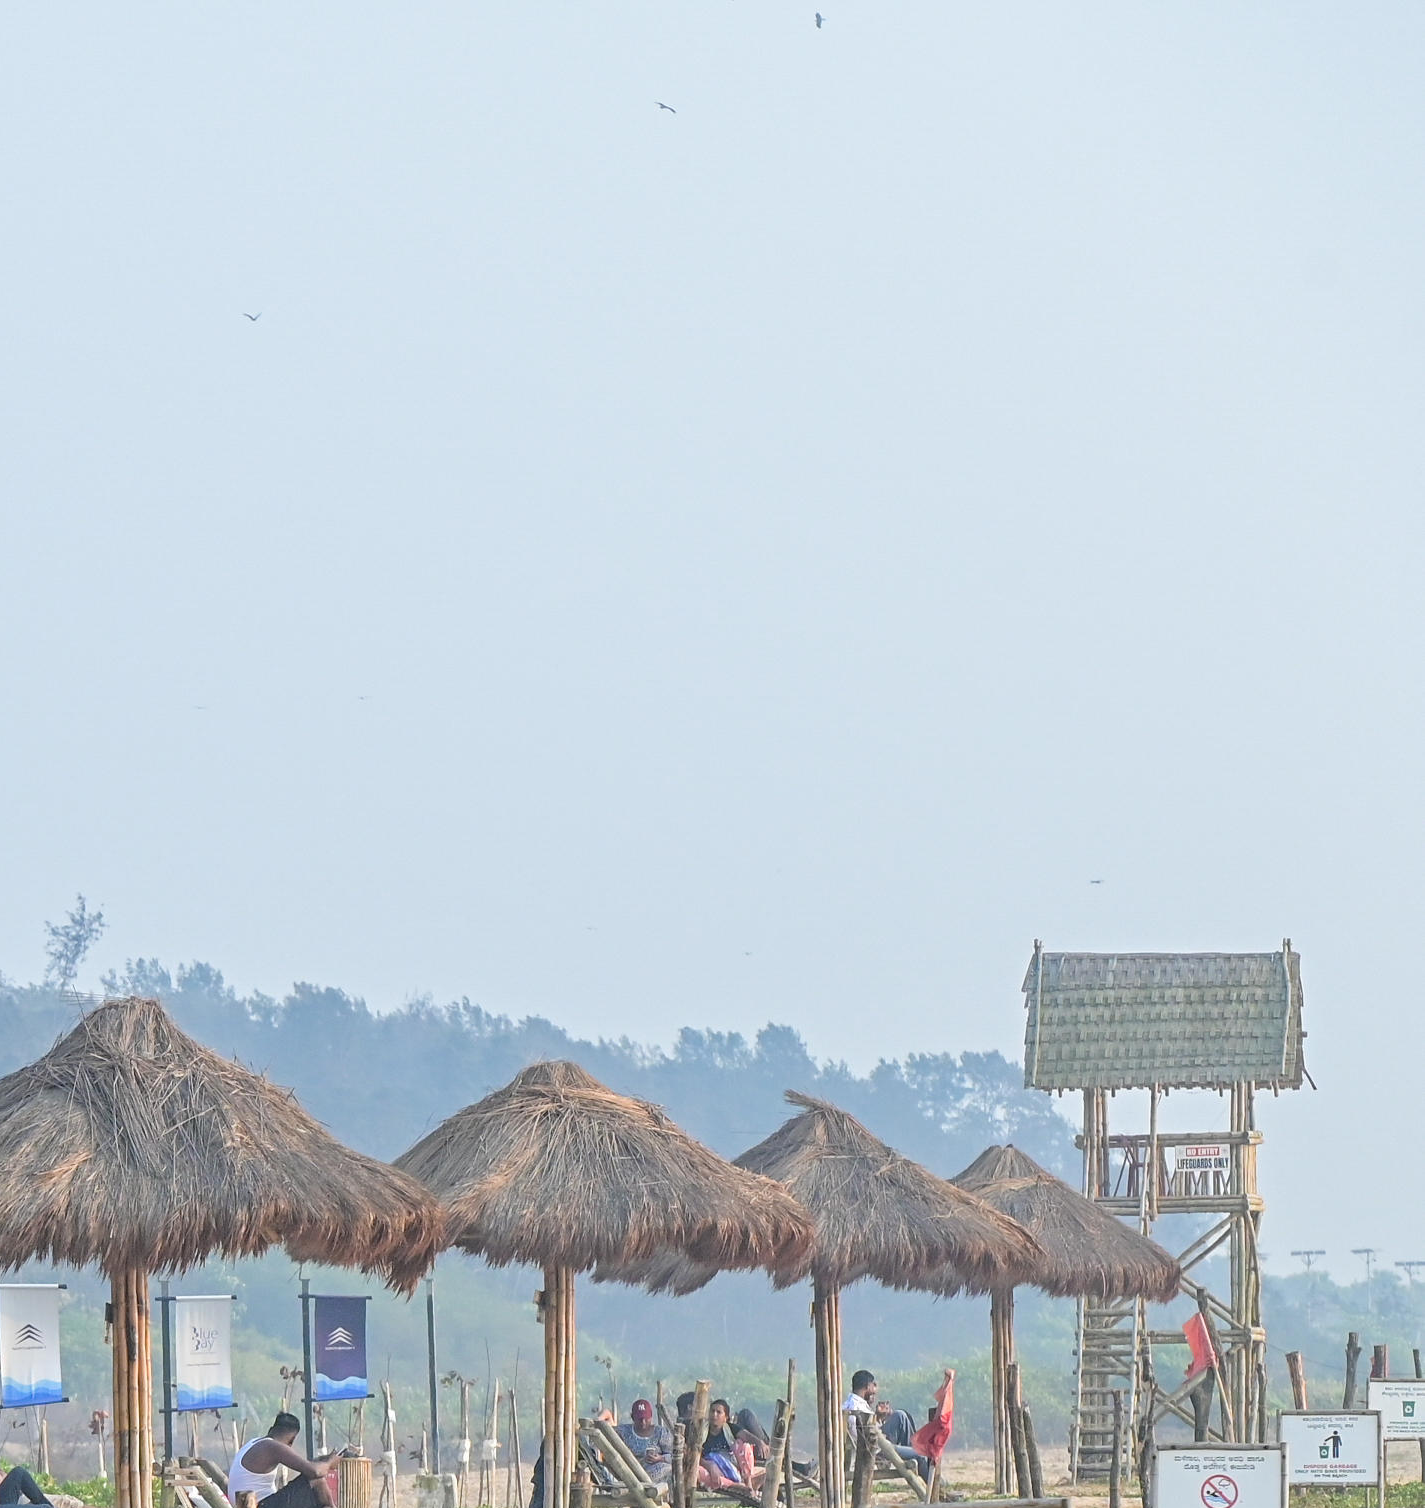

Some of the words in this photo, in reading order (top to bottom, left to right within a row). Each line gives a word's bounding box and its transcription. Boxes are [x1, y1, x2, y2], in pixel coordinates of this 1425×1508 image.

[1186, 1148, 1197, 1156] NO
[1198, 1147, 1219, 1156] ENTRY
[1177, 1158, 1212, 1169] LIFEGUARDS
[1214, 1157, 1229, 1168] ONLY
